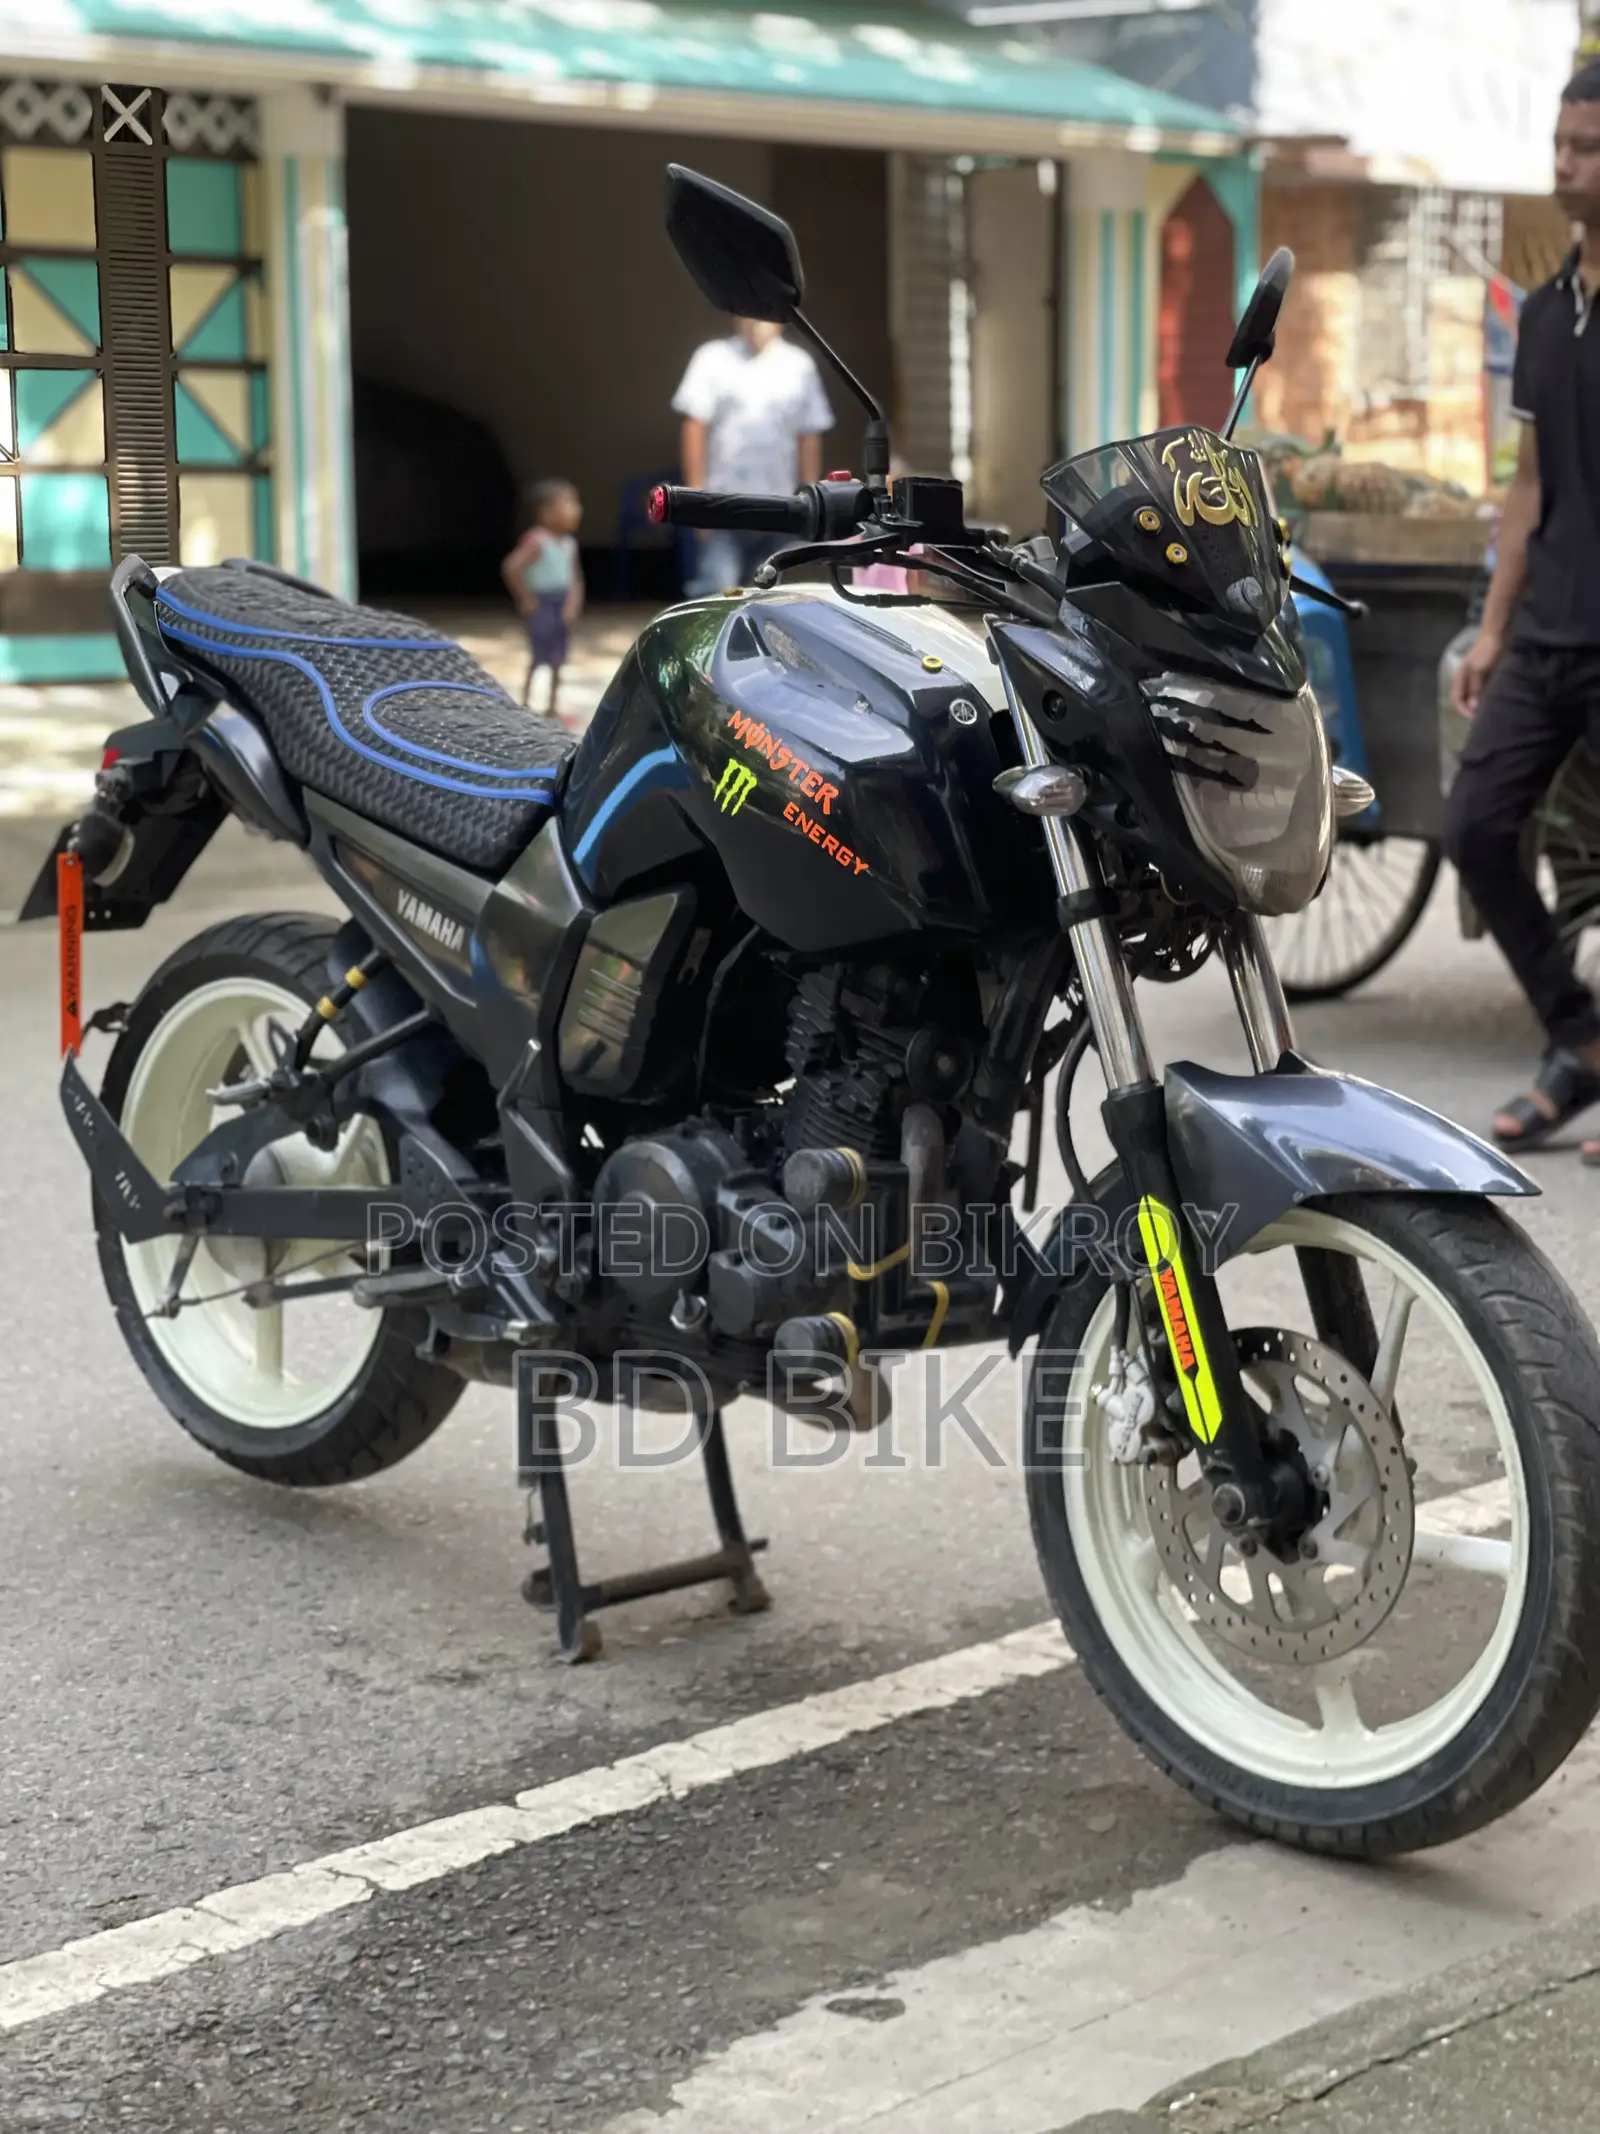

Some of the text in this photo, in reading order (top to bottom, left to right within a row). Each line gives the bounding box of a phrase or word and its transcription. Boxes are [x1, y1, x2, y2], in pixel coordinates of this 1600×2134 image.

[727, 709, 839, 815] MONSTER
[782, 801, 869, 875] ENERGY
[65, 904, 78, 999] WARNING
[397, 887, 465, 953] YAMAHA
[1158, 1266, 1196, 1371] YAMAHA
